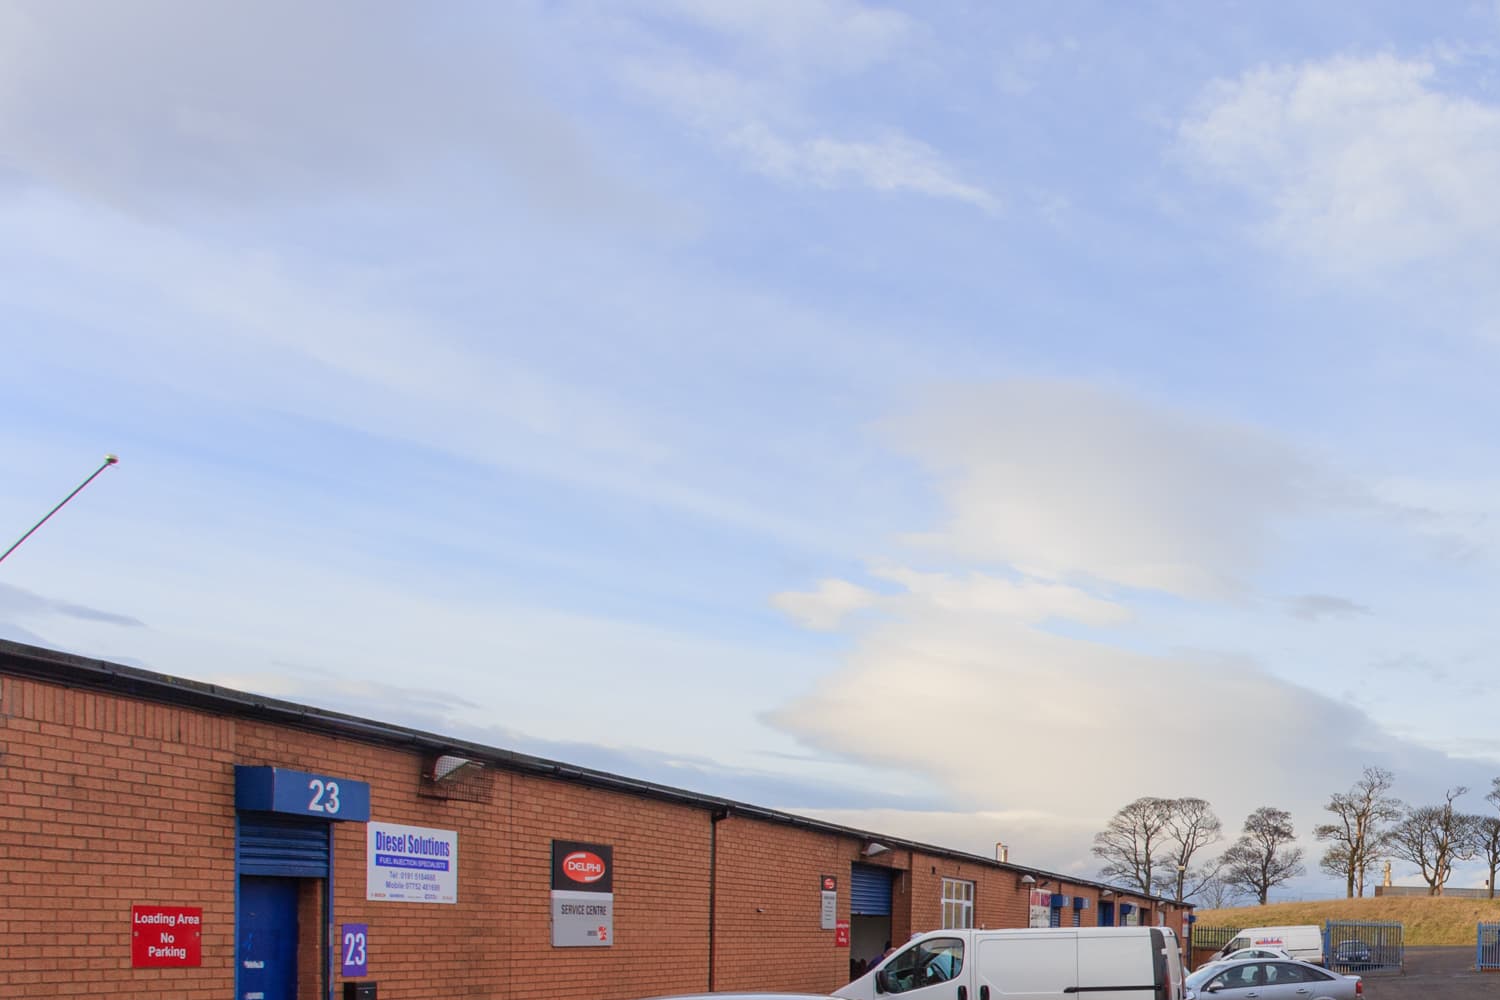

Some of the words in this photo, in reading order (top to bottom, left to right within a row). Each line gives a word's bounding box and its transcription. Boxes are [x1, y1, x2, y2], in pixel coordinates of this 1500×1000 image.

[309, 779, 340, 814] 23
[375, 831, 406, 853] Diesel
[408, 834, 450, 857] Solutions
[379, 856, 392, 864] FUEL
[568, 861, 601, 872] DELPHI
[561, 904, 585, 915] SERVICE
[586, 905, 607, 916] CENTRE
[135, 912, 175, 927] Loading
[177, 913, 200, 924] Area
[160, 932, 174, 943] No
[148, 946, 186, 959] Parking
[344, 932, 366, 966] 23
